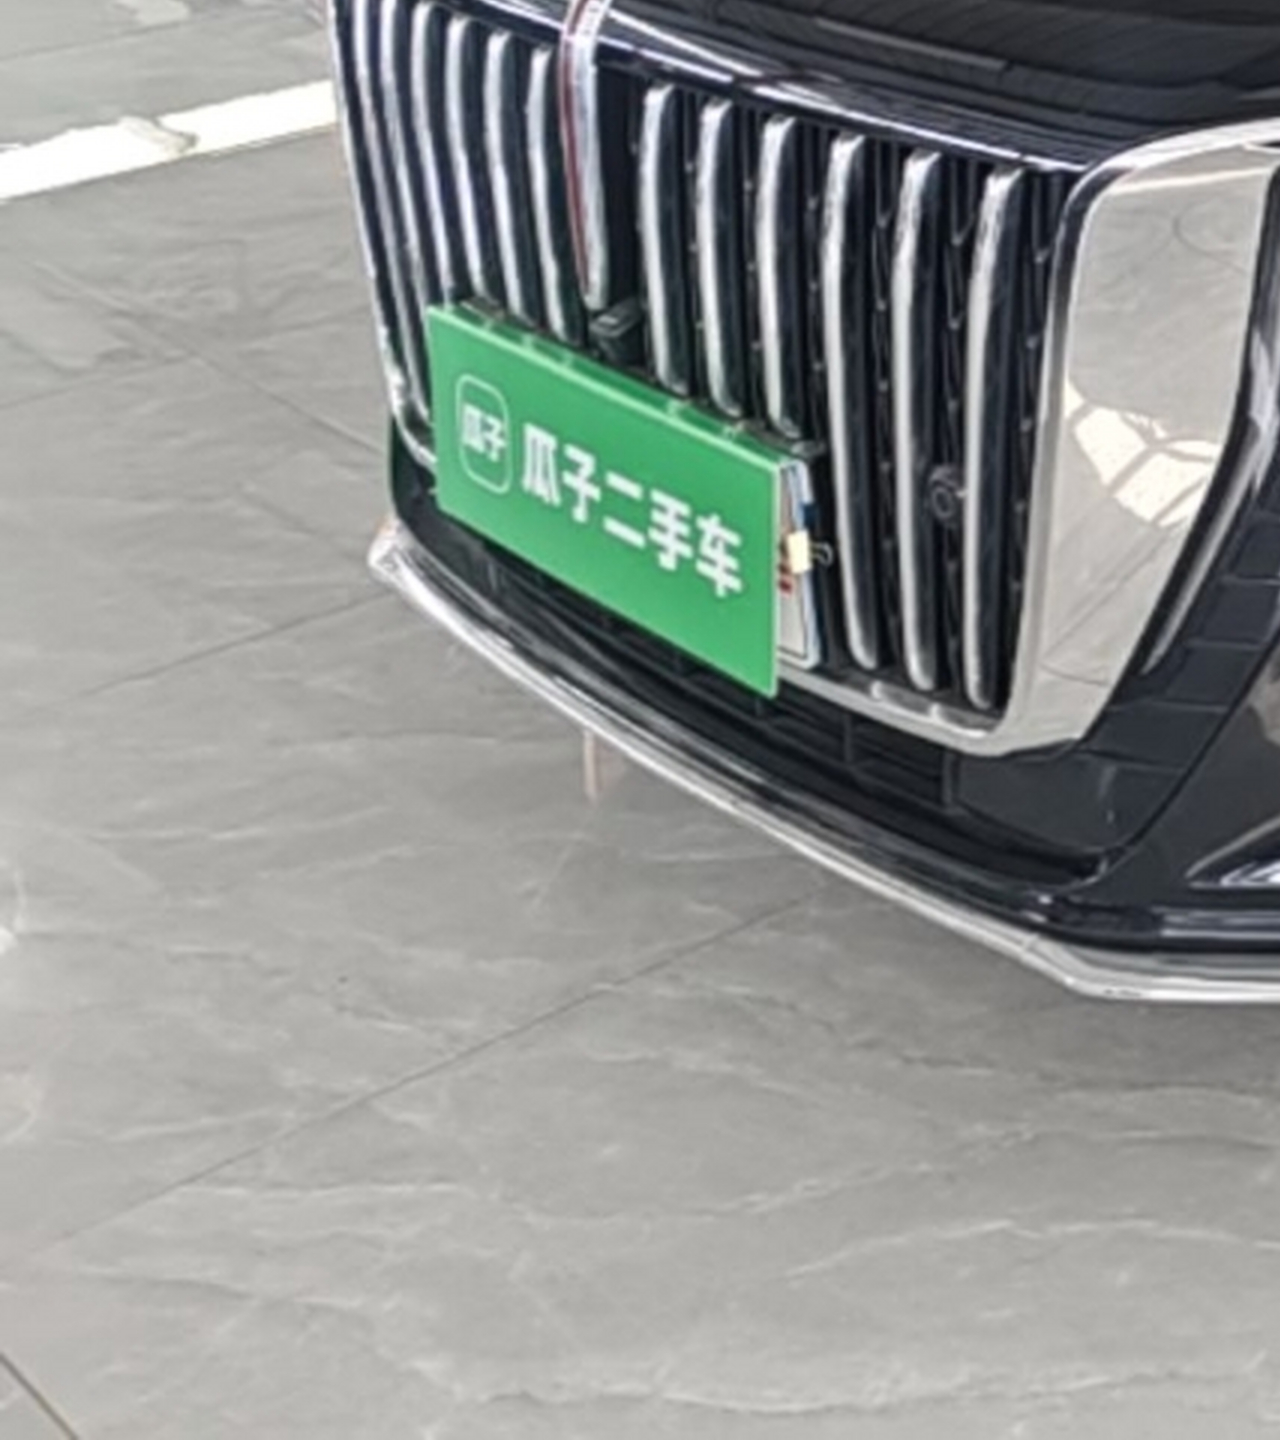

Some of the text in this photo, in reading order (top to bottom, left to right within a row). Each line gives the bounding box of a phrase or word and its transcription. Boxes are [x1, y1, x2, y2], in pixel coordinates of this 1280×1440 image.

[521, 422, 744, 599] 瓜子二手车
